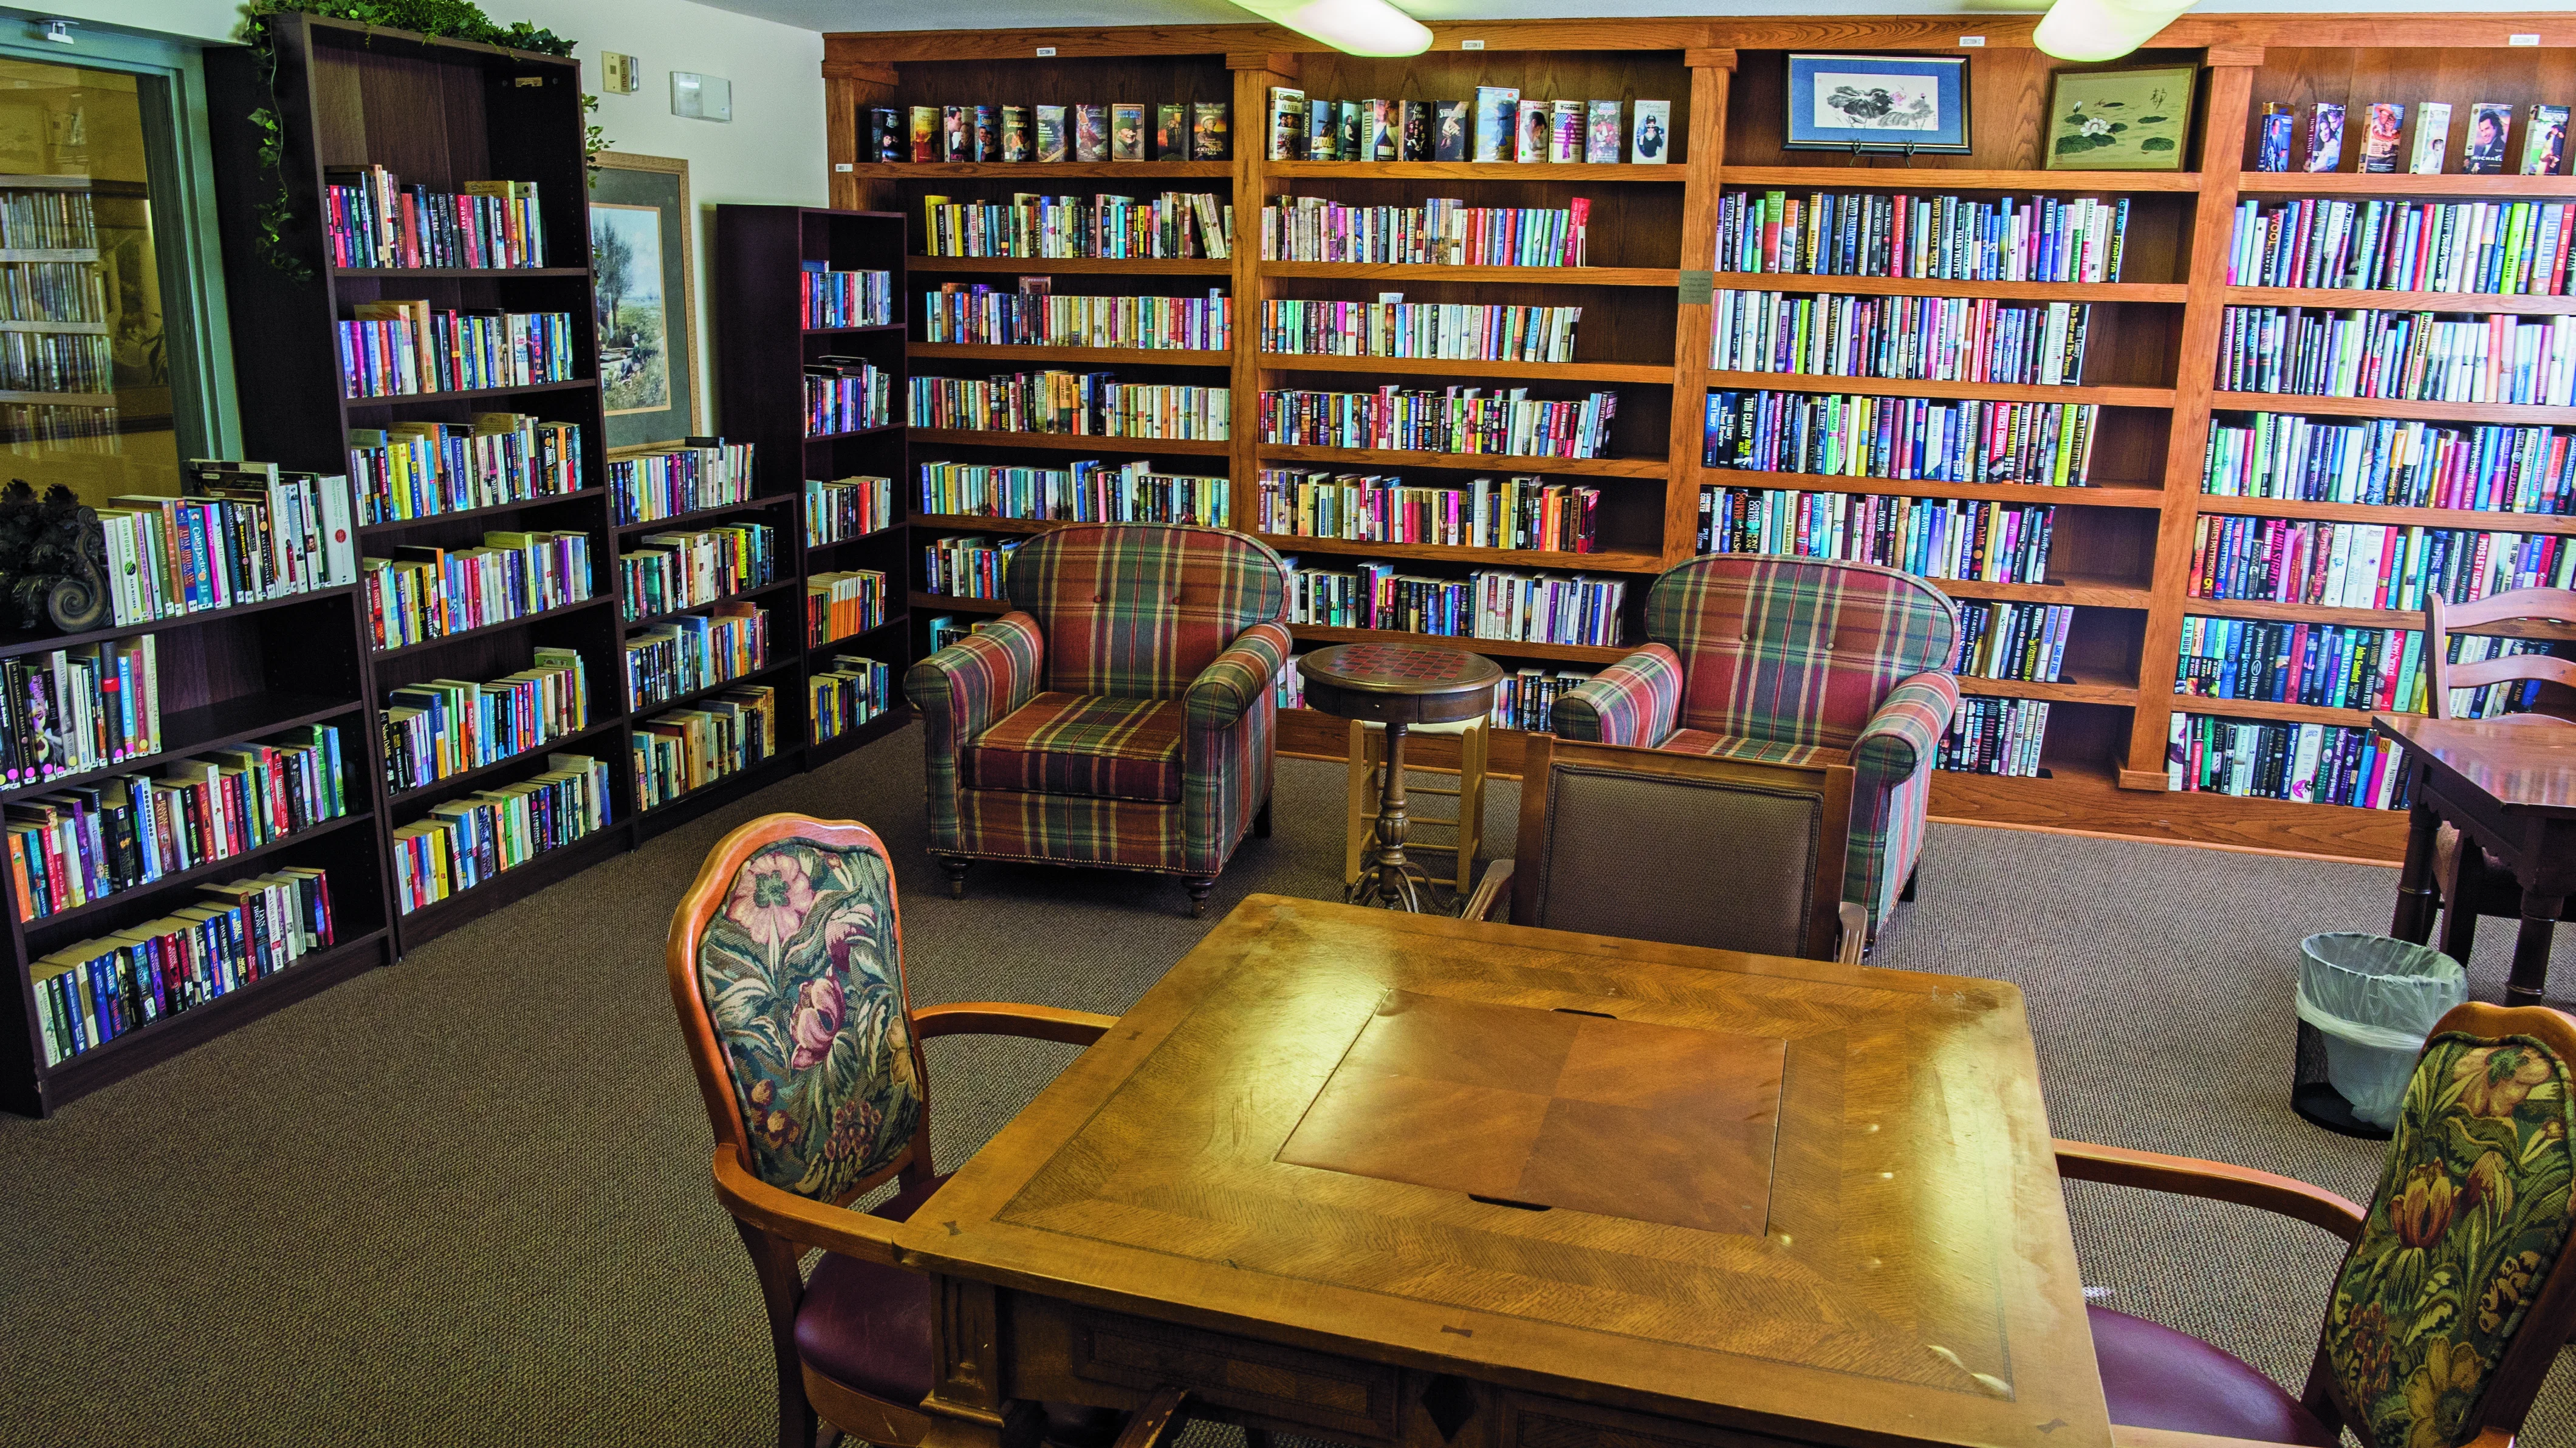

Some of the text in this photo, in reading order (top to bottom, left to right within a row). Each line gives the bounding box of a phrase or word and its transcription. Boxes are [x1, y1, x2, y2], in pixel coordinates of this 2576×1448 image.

[1363, 115, 1372, 143] TITANIC
[1846, 197, 1858, 245] DAVID BALDACCI
[1930, 217, 1939, 247] BALDACCI
[2268, 213, 2280, 247] WOOL
[1953, 249, 1962, 272] TRUTH
[2066, 344, 2075, 355] The
[2072, 325, 2086, 358] Tom Clancy
[2063, 356, 2074, 375] Dragon
[1726, 423, 1735, 440] Clancy
[1741, 397, 1754, 438] TOM CLANCY
[2006, 409, 2018, 456] PATRICIA CORNWELL
[1978, 449, 1987, 476] BLOWFLY
[457, 471, 466, 501] Coleridge
[2400, 479, 2410, 494] NOVEL
[2465, 489, 2473, 502] SALE
[2507, 463, 2519, 504] APPALOOSA
[1877, 510, 1885, 531] DEAVER
[1920, 513, 1929, 535] DEAVER
[1975, 506, 1989, 547] Nelson DeMille
[2040, 528, 2049, 550] BARRY
[2218, 521, 2232, 579] JAMES PATTERSON
[2206, 541, 2218, 576] PATTERSON
[2182, 636, 2191, 652] ROBB
[2228, 629, 2239, 661] NORA ROBERTS
[2403, 634, 2419, 682] Peachtree Road
[2351, 646, 2366, 682] John Sandford
[2366, 675, 2375, 694] PHANTOM
[1973, 718, 1982, 739] HIGGINS
